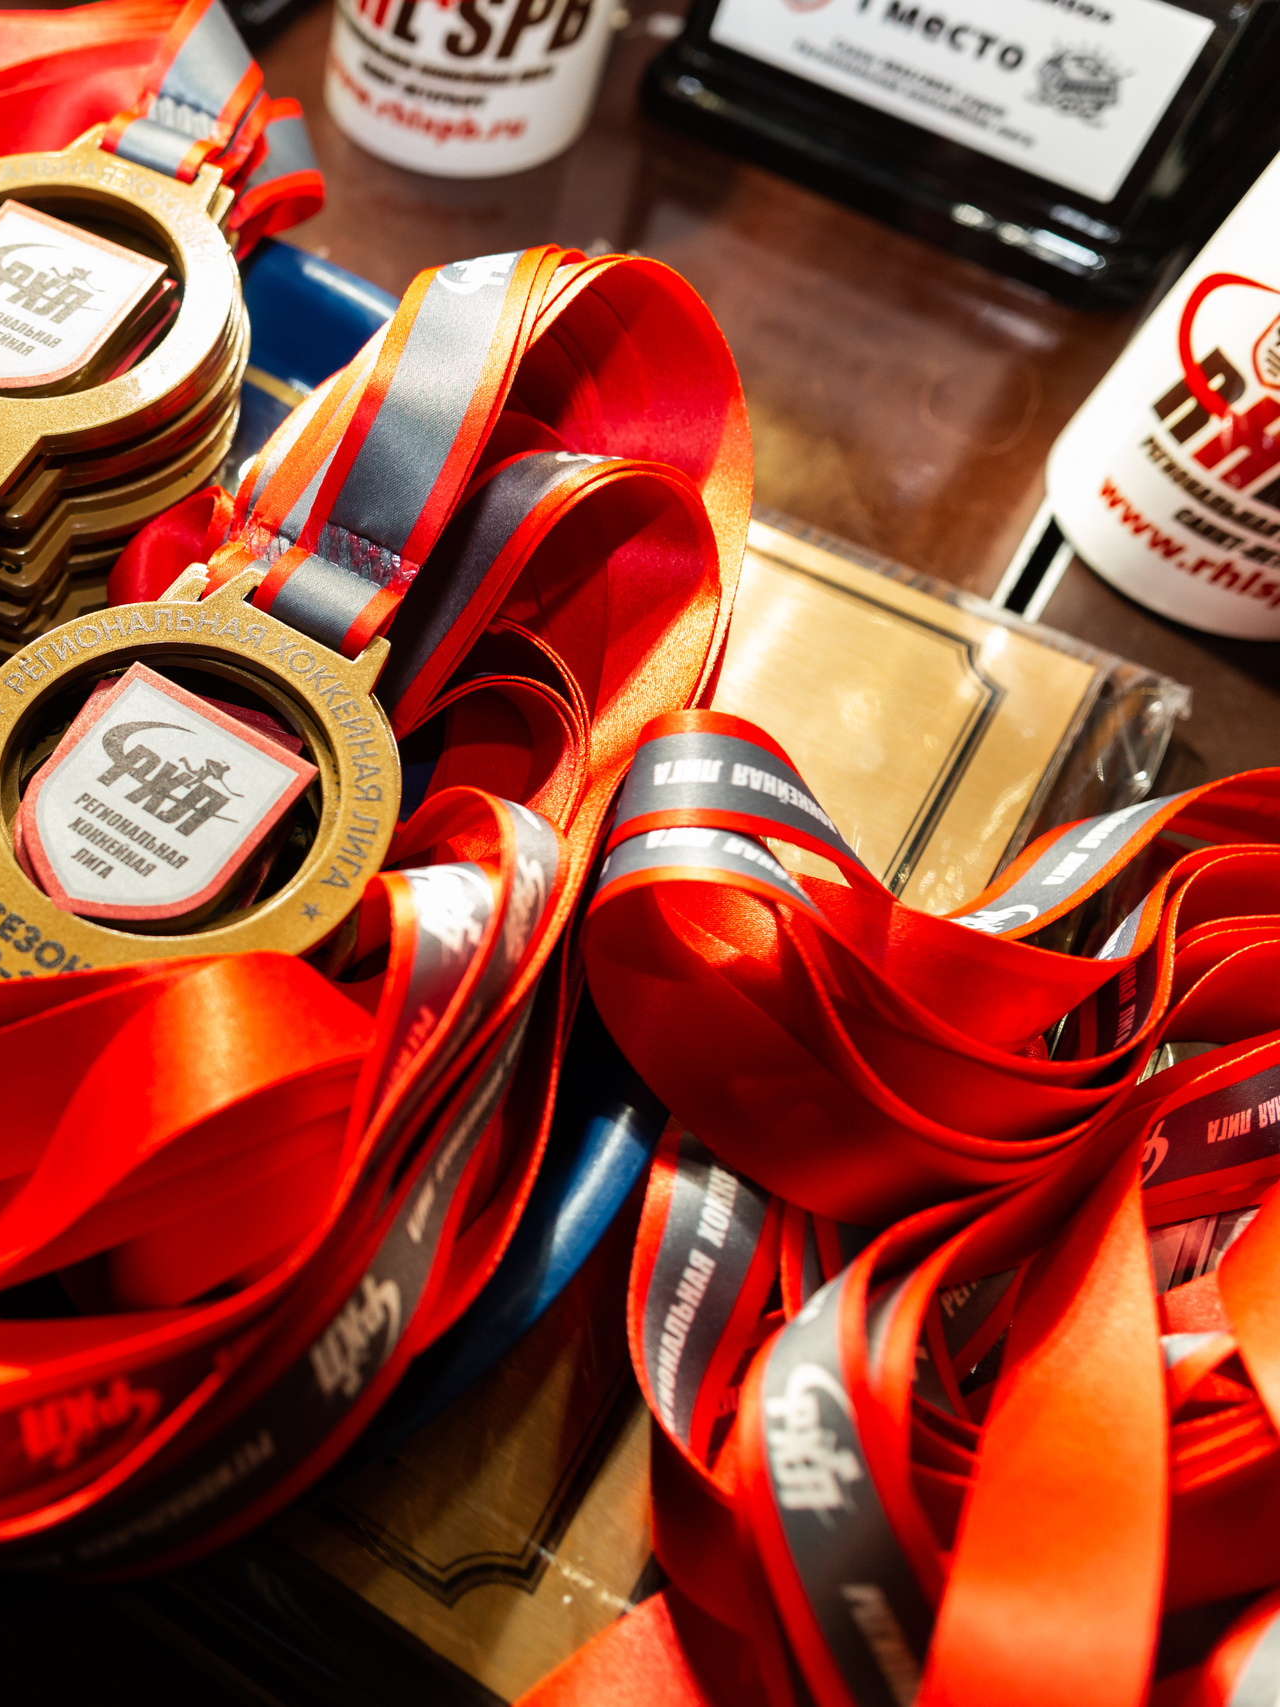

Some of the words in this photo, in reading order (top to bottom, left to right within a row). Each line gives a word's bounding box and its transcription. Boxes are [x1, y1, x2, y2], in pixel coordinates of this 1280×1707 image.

[3, 609, 268, 695] РЕГИОНАЛЬНАЯ
[265, 636, 382, 802] ХОККЕЙНАЯ
[67, 815, 158, 878] ХОККЕЙНАЯ
[70, 845, 116, 880] ЛИГА
[74, 792, 190, 870] РЕГИОНАЛЬНАЯ
[320, 809, 381, 891] ЛИГА
[1207, 1107, 1253, 1144] ЛИГА
